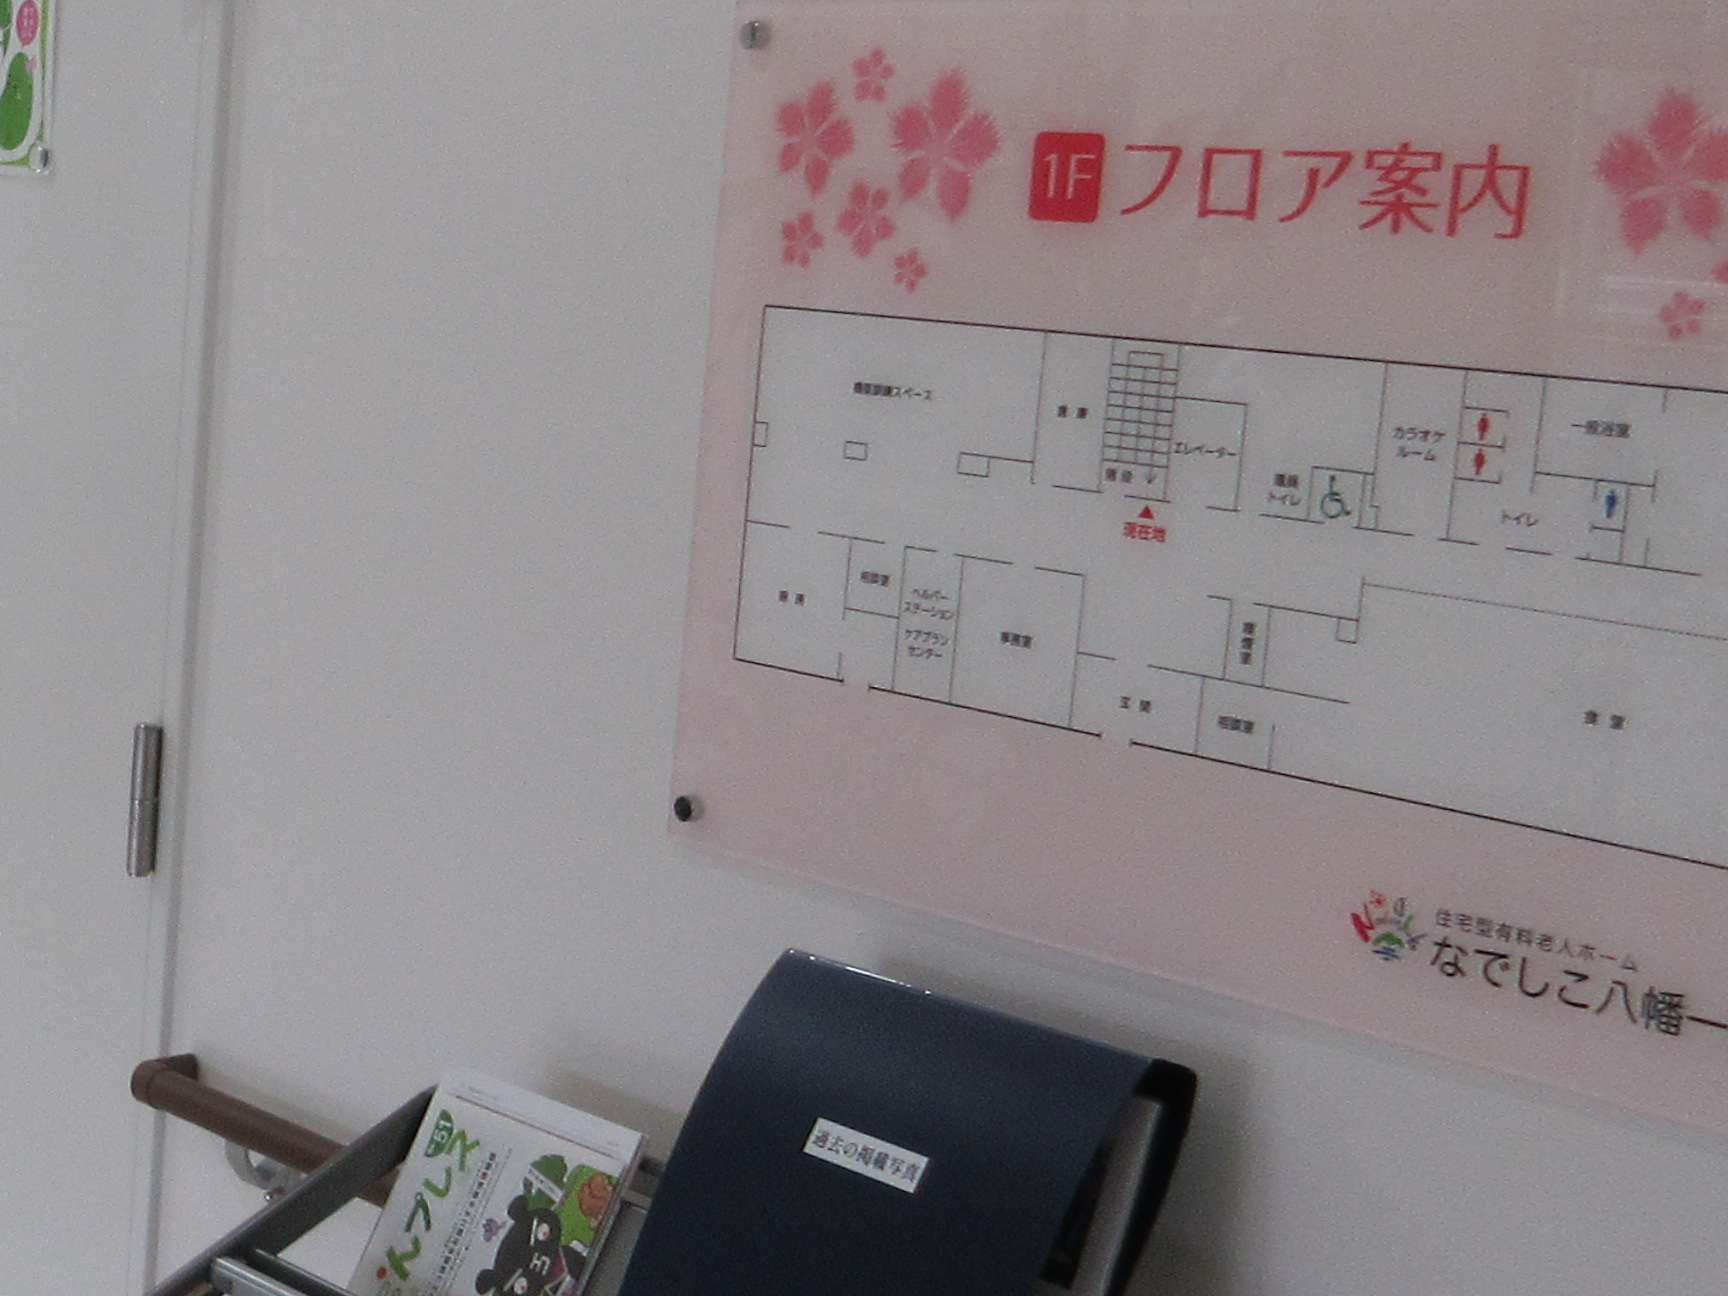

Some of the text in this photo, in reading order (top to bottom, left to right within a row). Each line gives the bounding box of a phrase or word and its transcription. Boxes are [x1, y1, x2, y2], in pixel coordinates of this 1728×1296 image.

[1042, 140, 1532, 241] 1F フロア案内
[1434, 908, 1639, 972] 住宅型有料老人ホーム
[812, 1128, 921, 1184] 過去の掲載写真
